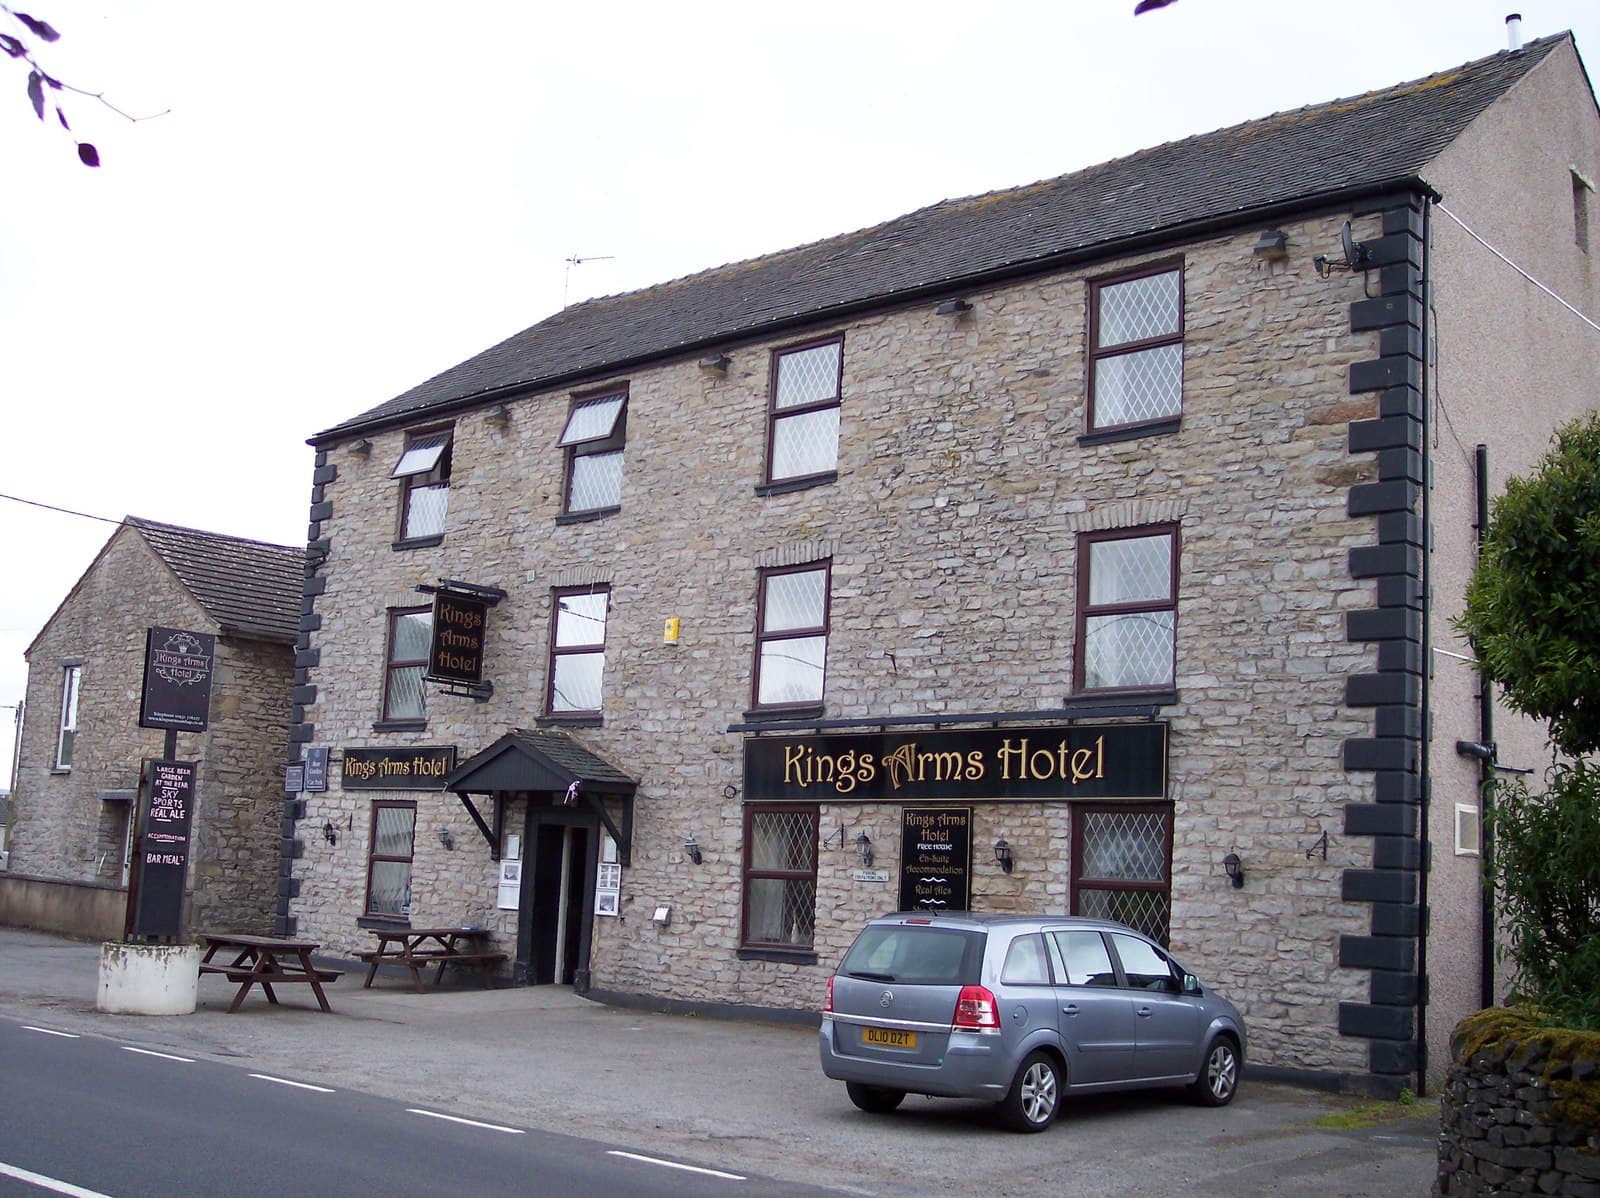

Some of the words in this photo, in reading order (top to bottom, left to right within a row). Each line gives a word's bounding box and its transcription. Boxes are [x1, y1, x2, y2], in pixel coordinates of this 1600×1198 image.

[440, 603, 481, 629] Kings
[440, 629, 478, 649] Arms
[160, 653, 181, 665] Kings
[184, 657, 204, 668] Arms
[439, 651, 476, 671] Hotel
[171, 668, 192, 678] Hotel
[156, 766, 175, 774] LARGE
[345, 757, 376, 780] Kings
[378, 756, 410, 778] Arms
[412, 756, 448, 777] Hotel
[783, 746, 876, 793] Kings
[881, 742, 985, 790] Arms
[997, 735, 1105, 785] Hotel
[161, 773, 183, 781] GARDEN
[161, 789, 180, 799] SKY
[153, 797, 183, 809] SPORTS
[150, 808, 168, 818] REAL
[169, 809, 185, 819] ALE
[906, 812, 934, 828] Kings
[937, 812, 966, 828] Arms
[921, 829, 949, 842] Hotel
[146, 853, 161, 864] BAR
[915, 884, 933, 896] Real
[934, 885, 952, 896] Ales
[868, 1029, 888, 1043] DL10
[891, 1031, 910, 1045] DZT
